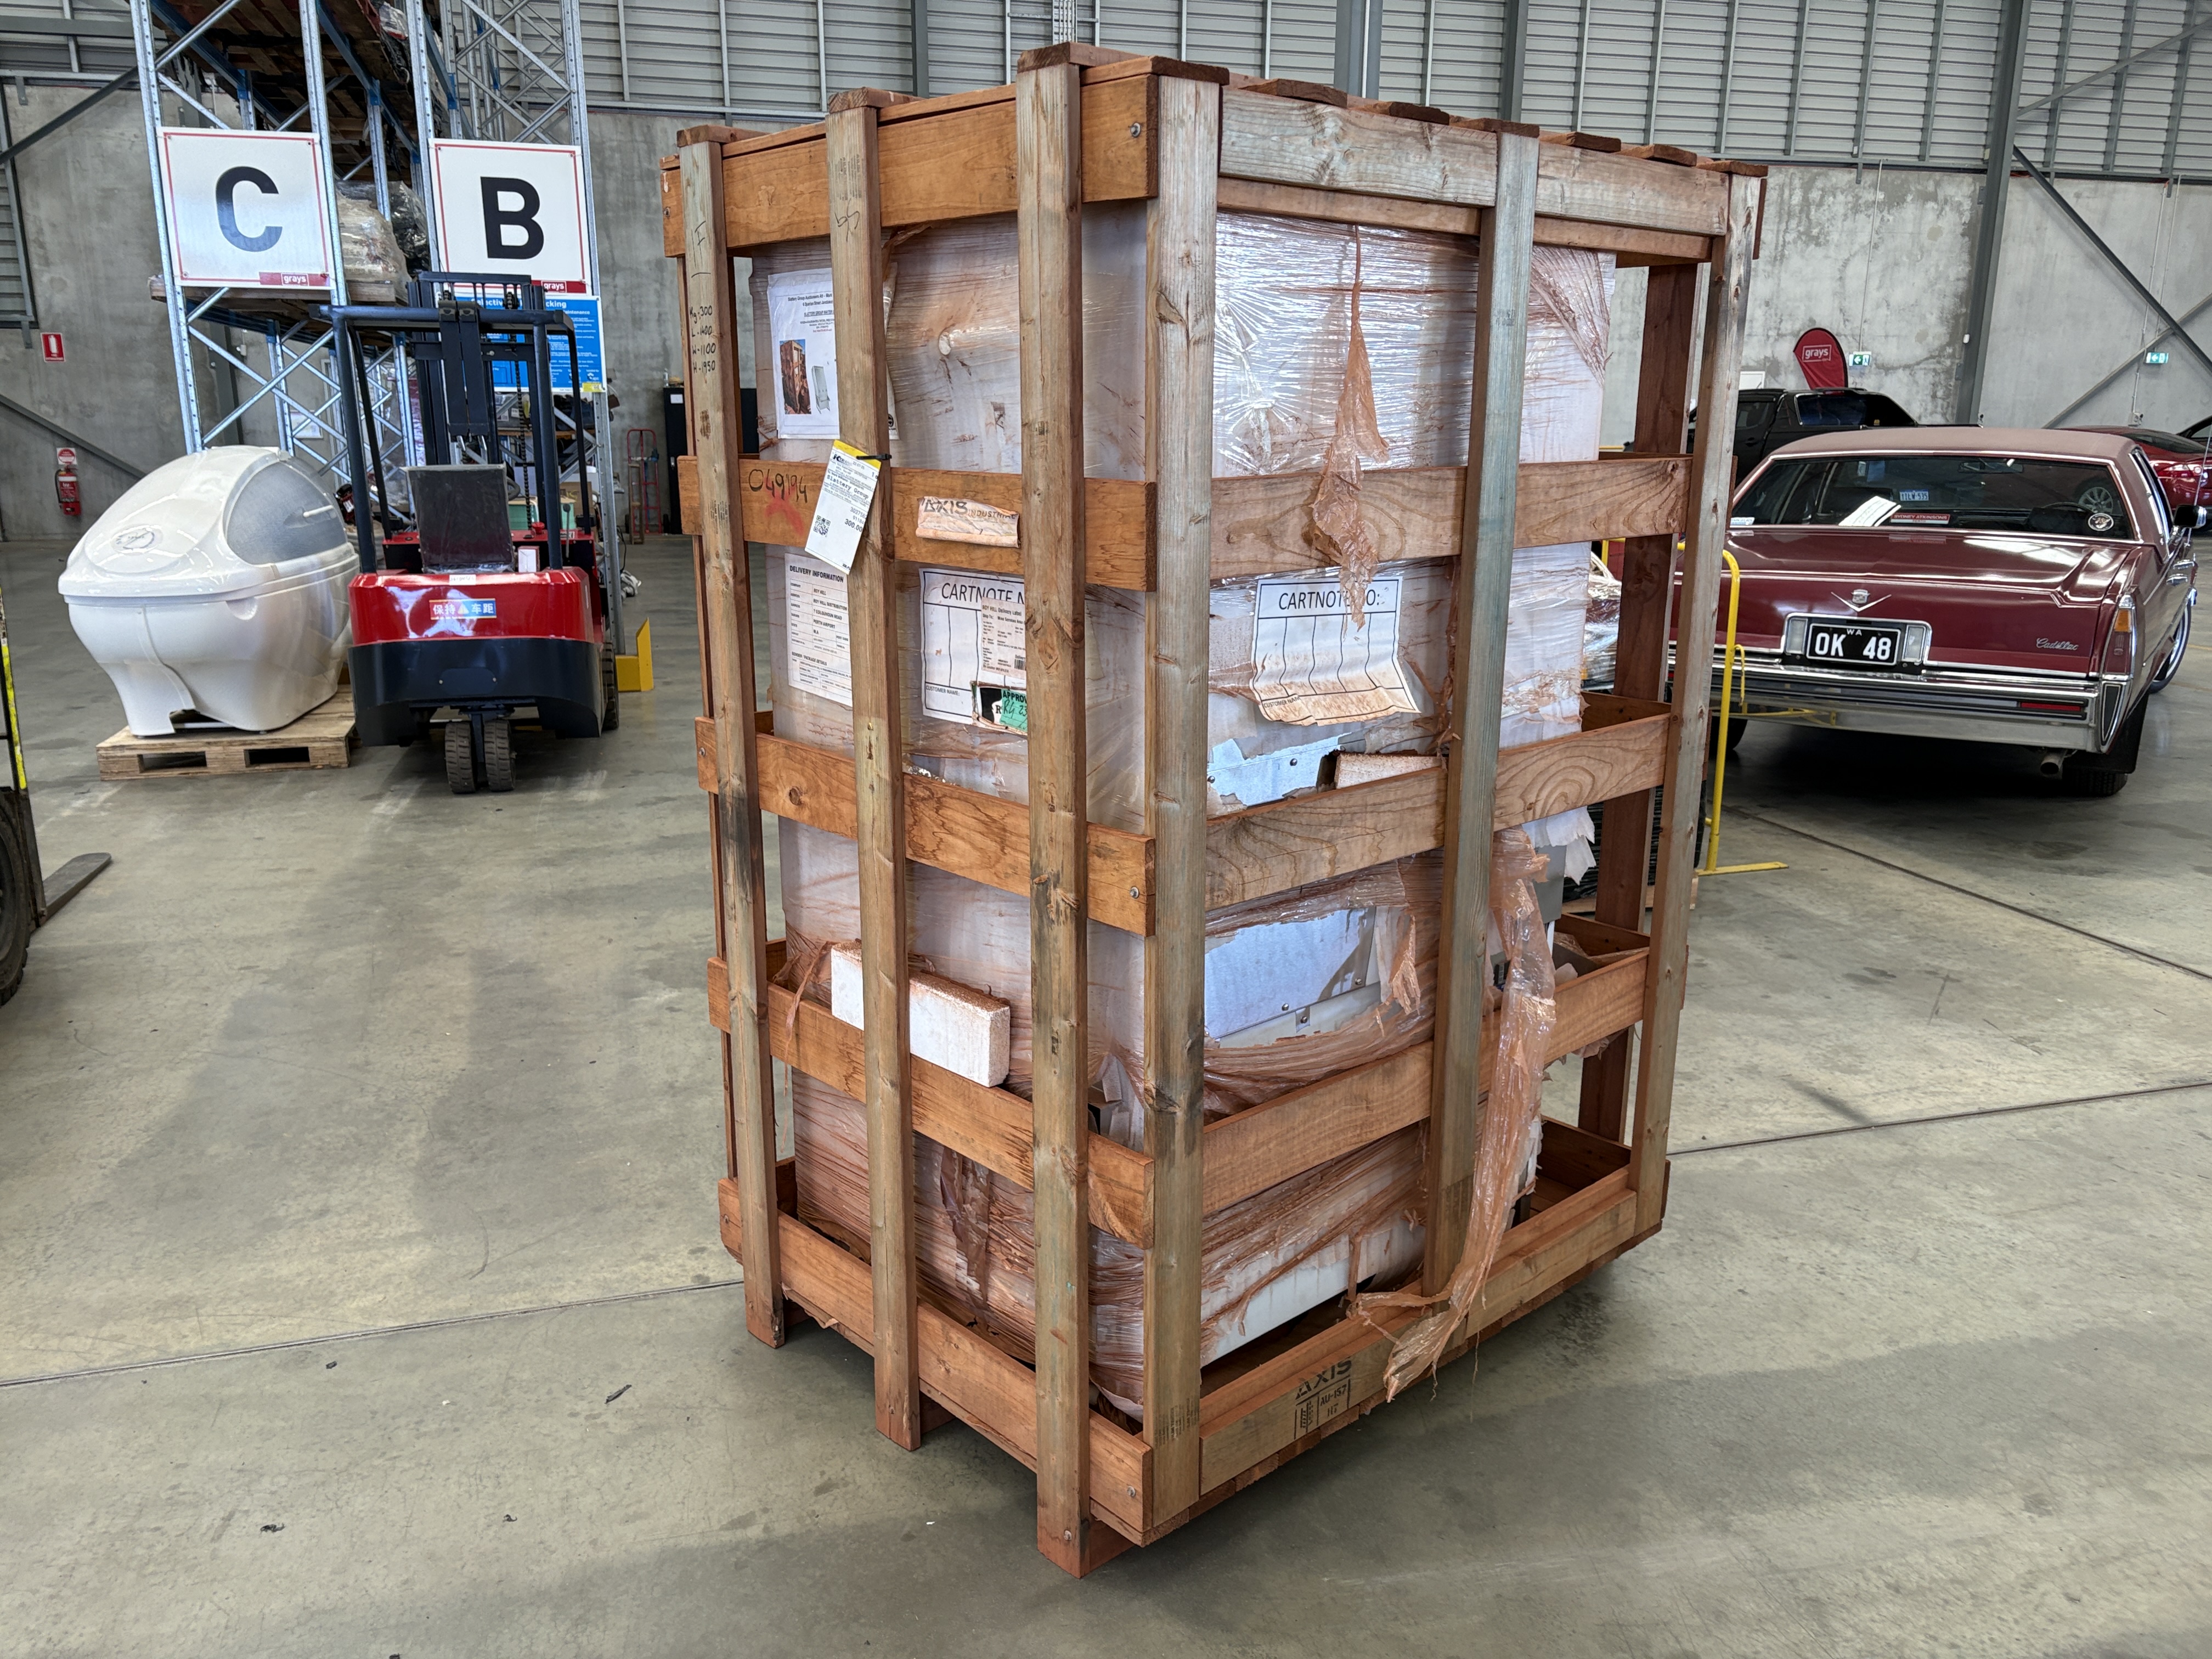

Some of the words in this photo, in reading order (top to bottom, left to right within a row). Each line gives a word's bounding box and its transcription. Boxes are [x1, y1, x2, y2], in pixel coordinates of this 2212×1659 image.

[216, 166, 283, 252] C
[481, 176, 544, 259] B
[284, 275, 307, 284] grays
[1805, 348, 1829, 359] grays
[826, 474, 851, 490] Slattery
[854, 488, 869, 500] Group
[789, 565, 812, 576] DELIVERY
[812, 571, 844, 583] INFORMATION
[941, 583, 1013, 603] CARTNOTE
[432, 603, 455, 615] 保持
[471, 603, 494, 614] 车距
[1815, 632, 1846, 657] OK
[1863, 636, 1892, 661] 48
[2036, 637, 2079, 651] Cadillac
[926, 685, 946, 693] CUSTOMER
[1263, 700, 1287, 708] CUSTOMER
[1295, 1357, 1352, 1400] AXIS
